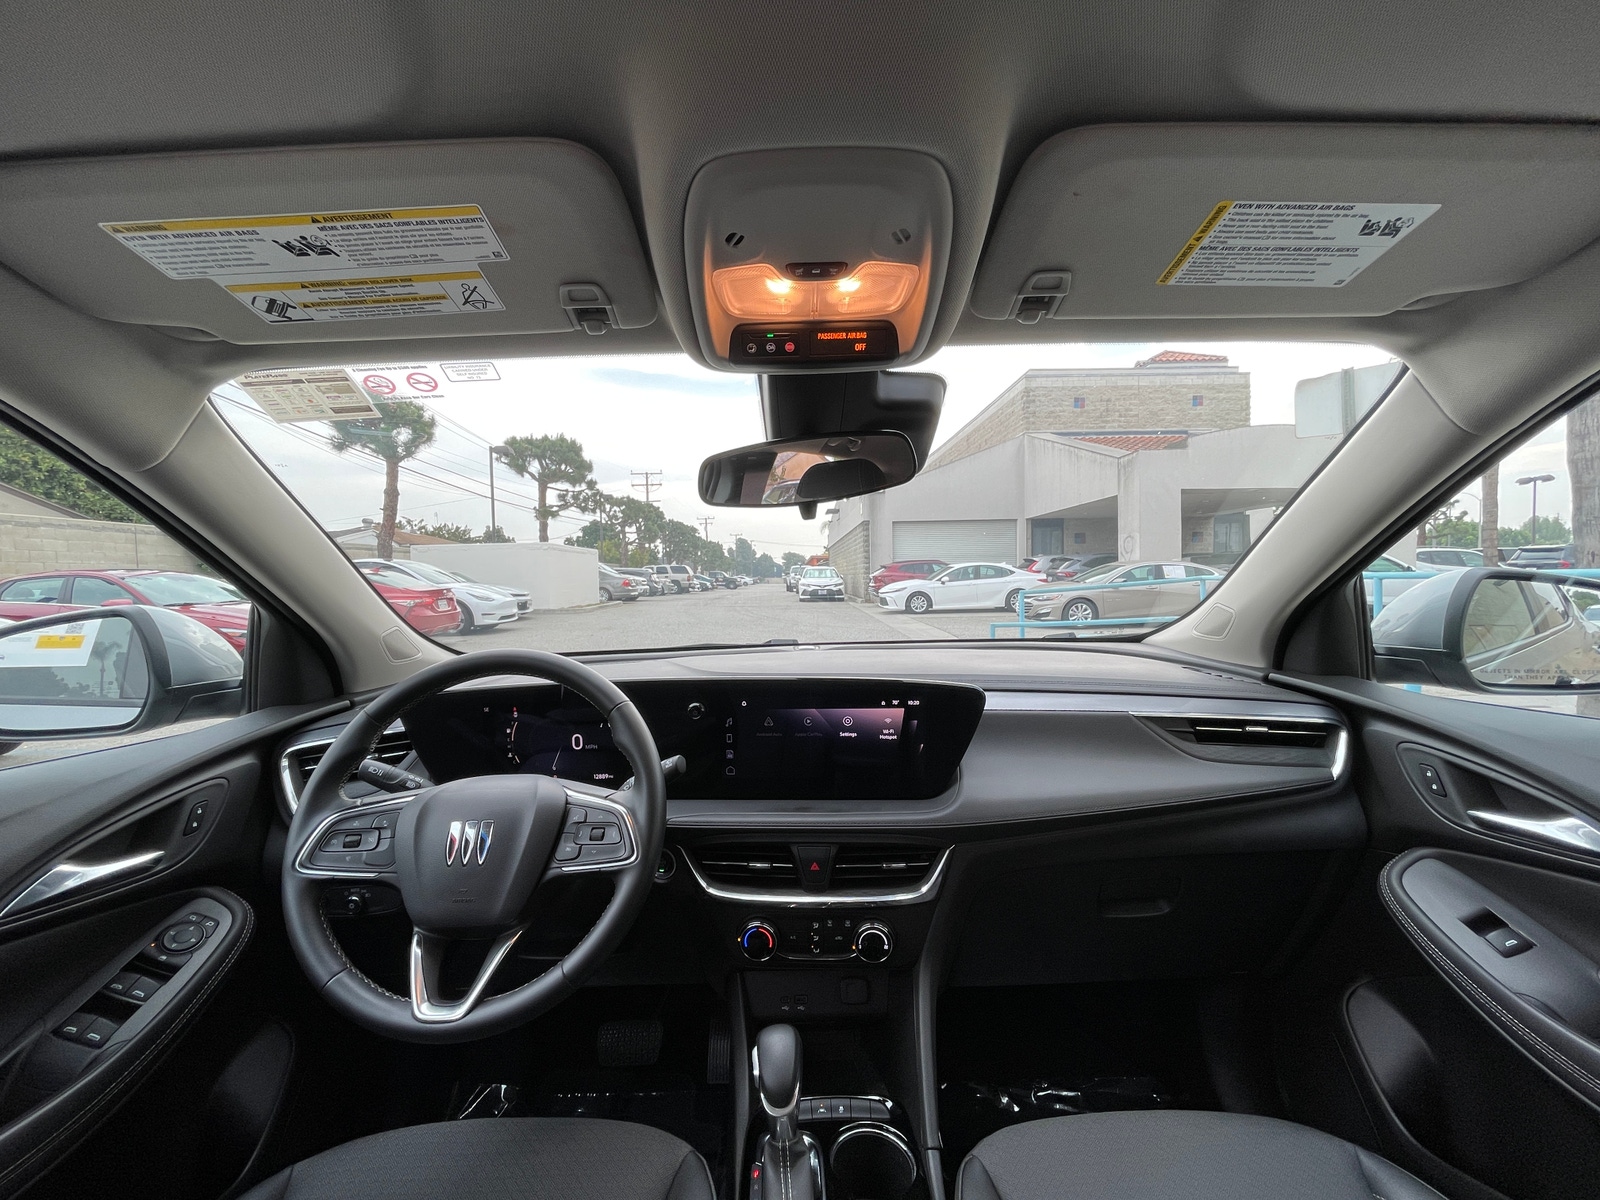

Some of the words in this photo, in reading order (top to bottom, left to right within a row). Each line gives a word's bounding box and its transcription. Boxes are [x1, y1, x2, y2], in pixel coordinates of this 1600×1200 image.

[322, 213, 392, 222] AVERTISSEMENT
[438, 217, 484, 225] INTELLIGENTS
[1198, 205, 1227, 234] WARNING
[854, 343, 867, 351] OFF
[572, 734, 583, 750] 0
